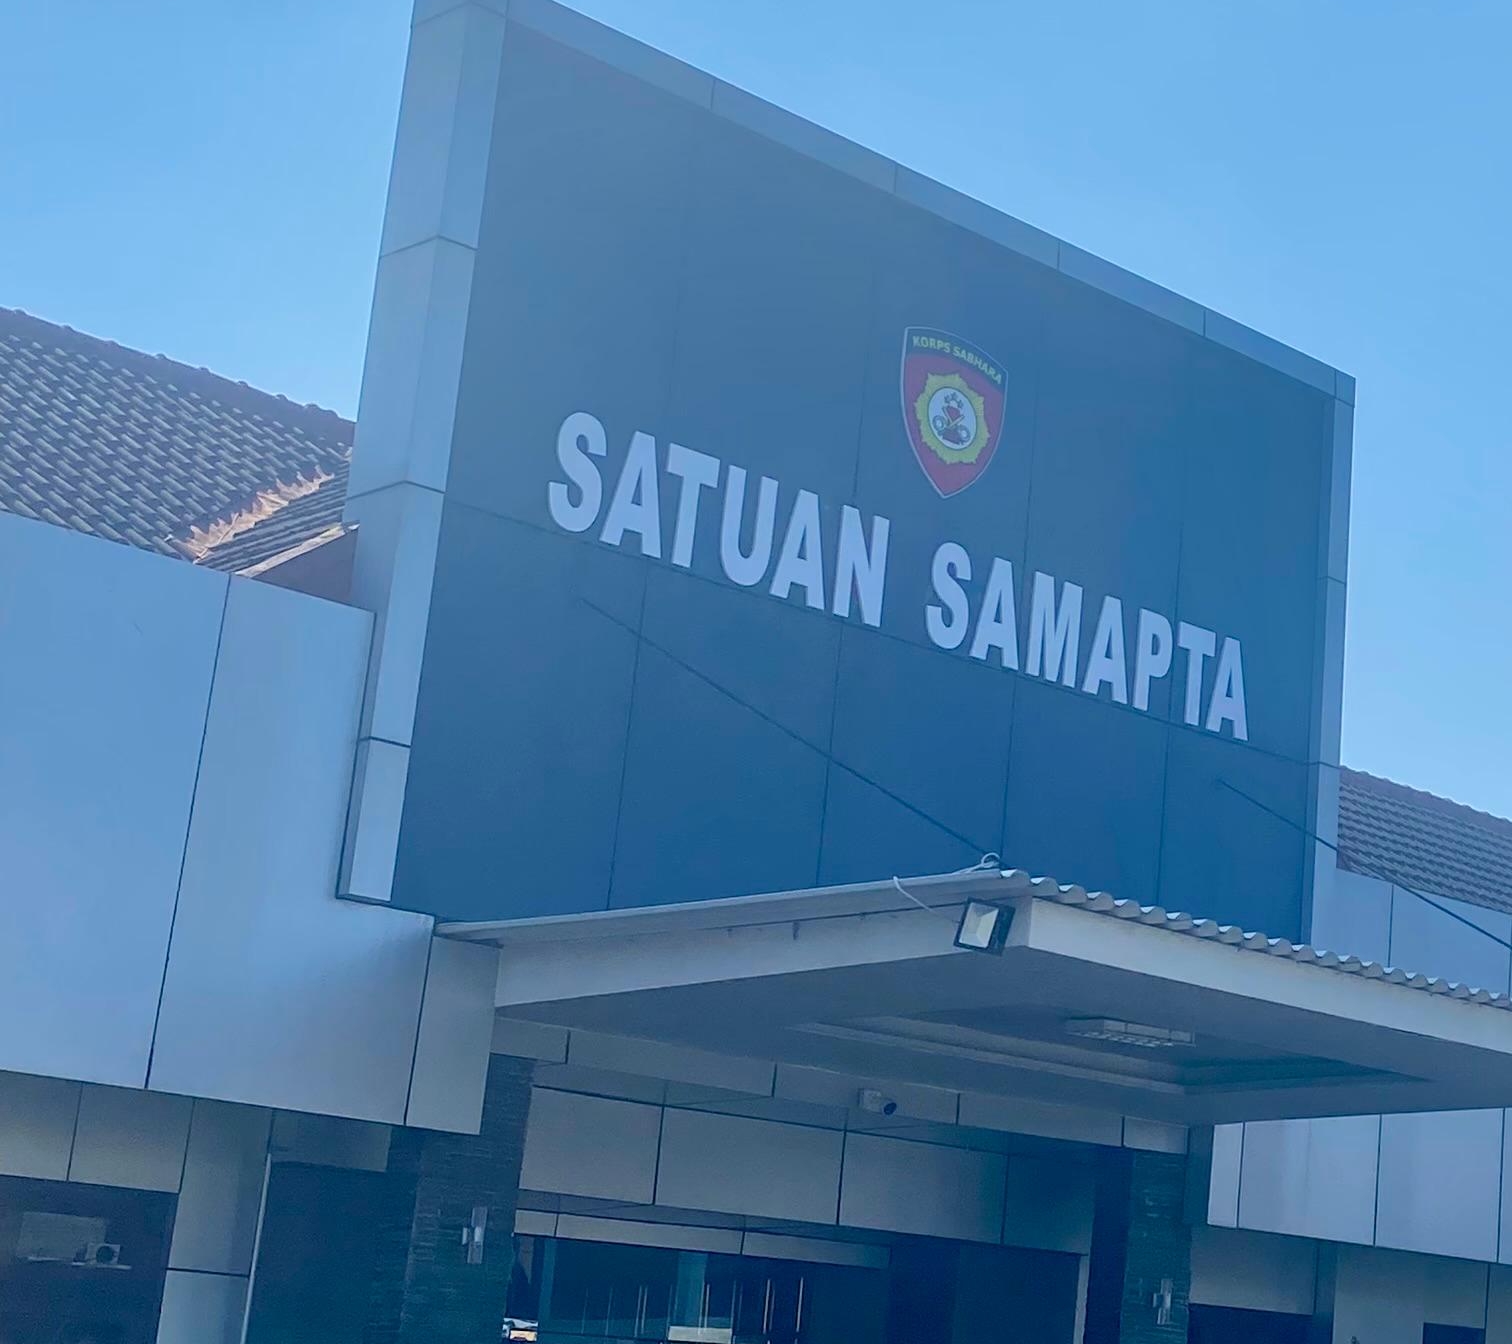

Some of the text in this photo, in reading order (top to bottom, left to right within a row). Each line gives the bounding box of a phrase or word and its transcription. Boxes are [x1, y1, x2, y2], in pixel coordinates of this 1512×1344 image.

[912, 334, 1003, 385] KORPS SABHARA
[547, 411, 1249, 741] SATUAN SAMAPTA
